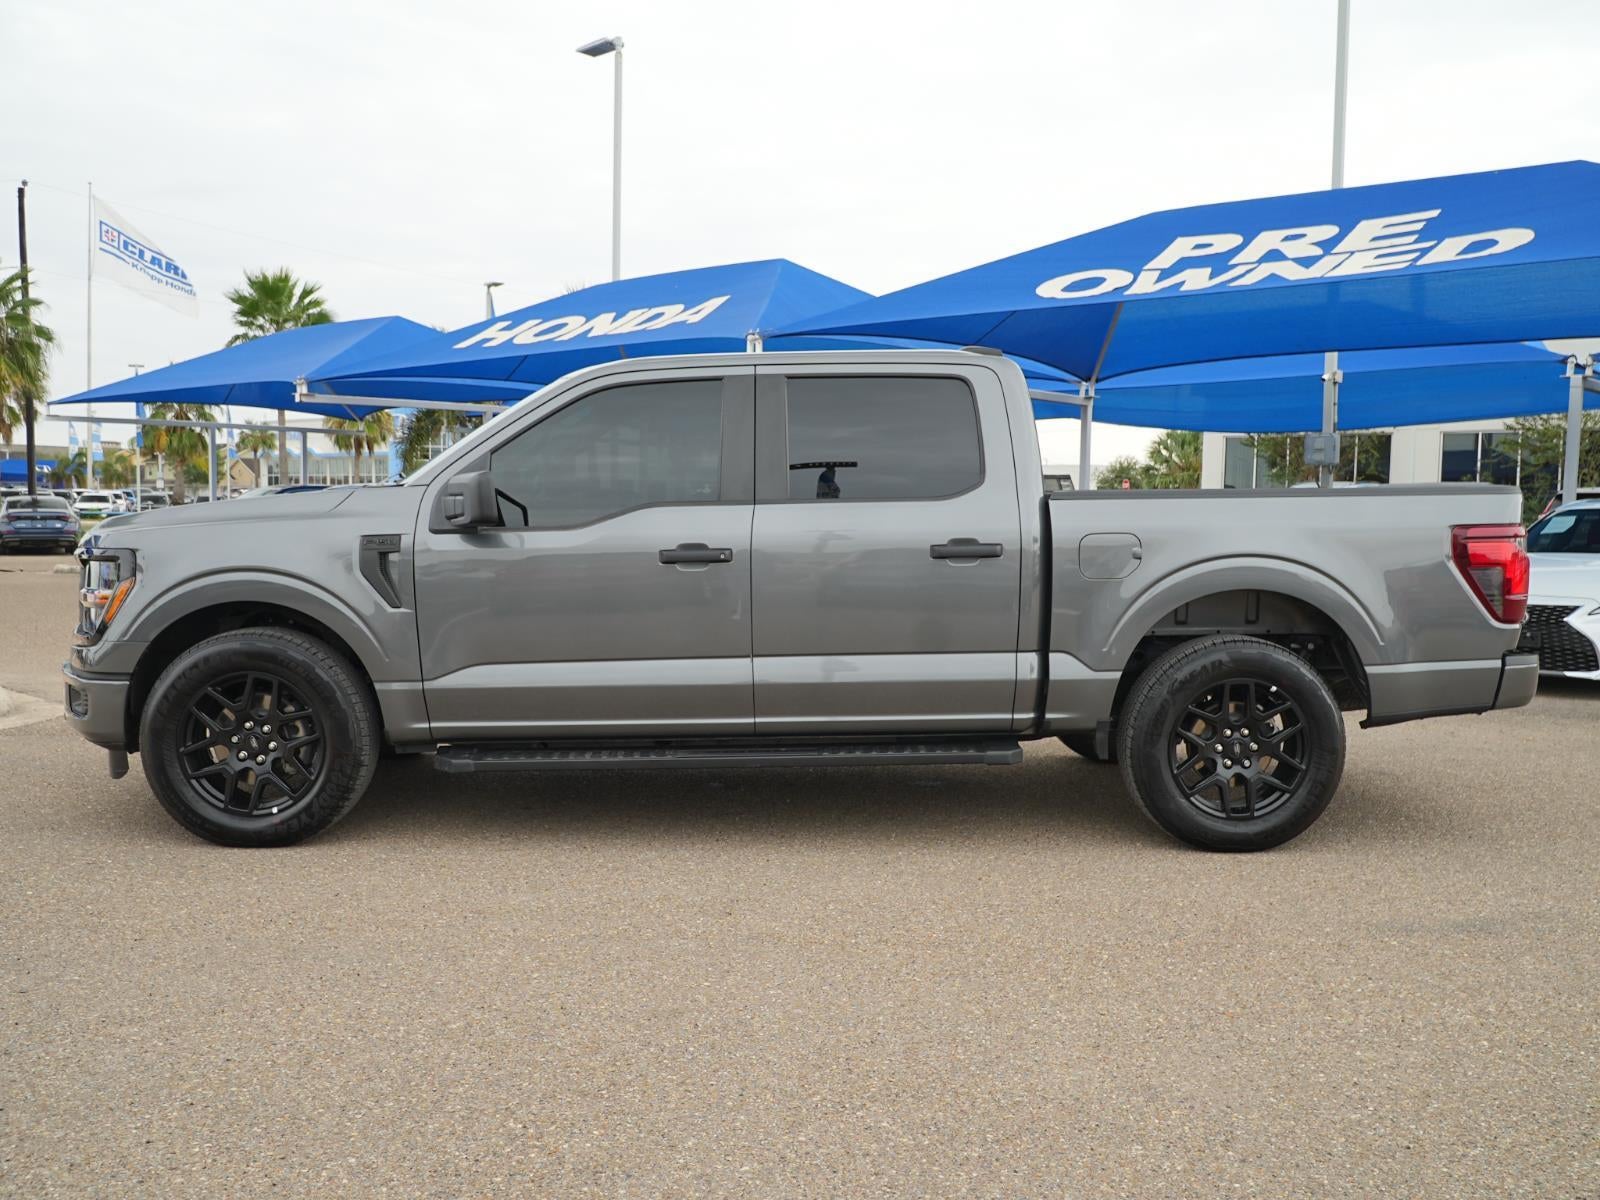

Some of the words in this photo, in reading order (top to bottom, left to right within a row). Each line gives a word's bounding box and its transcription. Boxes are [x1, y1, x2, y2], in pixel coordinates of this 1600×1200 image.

[1035, 227, 1535, 299] OWNED
[1142, 208, 1442, 270] PRE
[452, 295, 732, 349] HONDA
